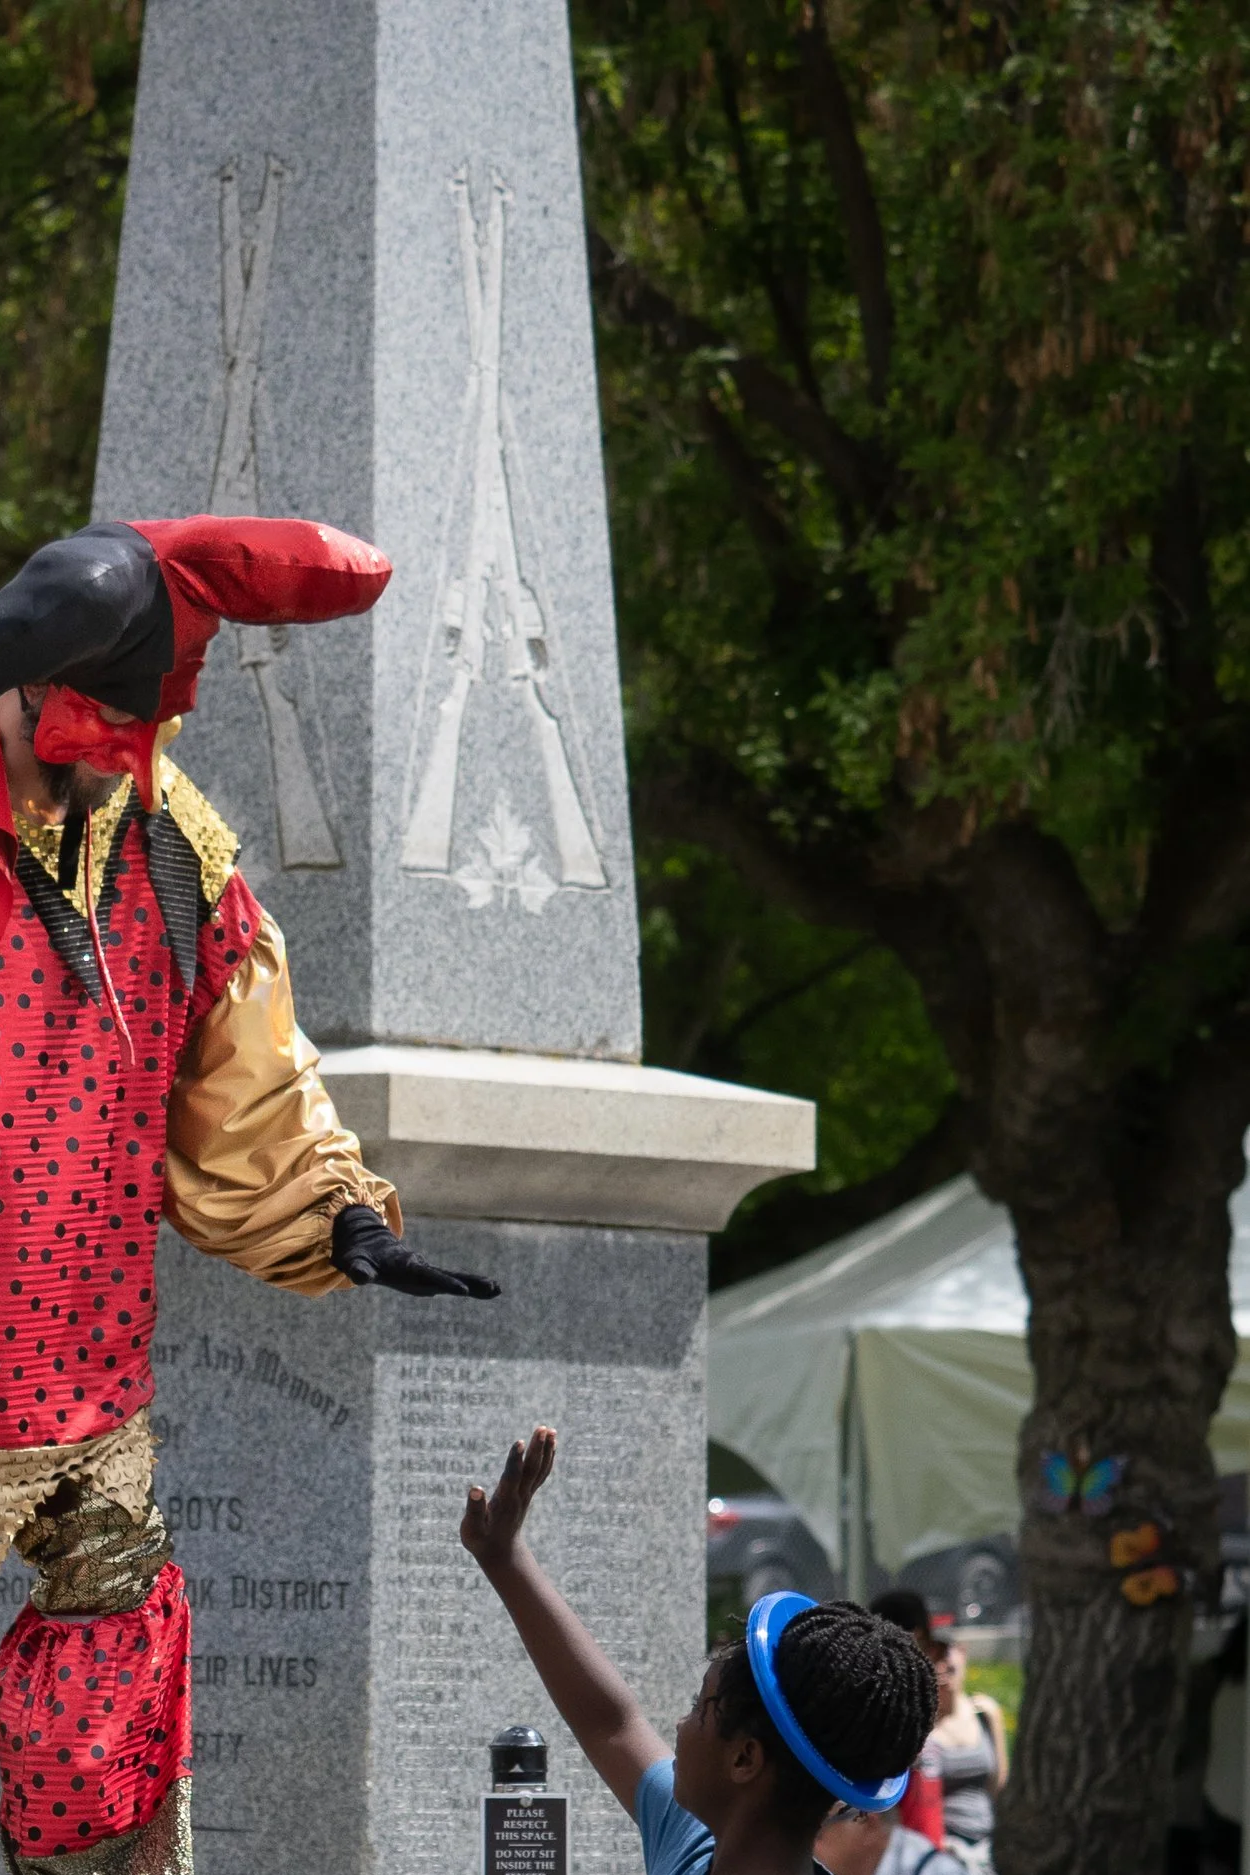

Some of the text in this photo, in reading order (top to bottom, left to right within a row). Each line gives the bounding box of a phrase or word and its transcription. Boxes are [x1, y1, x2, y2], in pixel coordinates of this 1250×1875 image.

[166, 1495, 244, 1532] BOYS
[231, 1575, 351, 1611] DISTRICT
[192, 1655, 318, 1687] EIR LIVES
[506, 1808, 545, 1818] PLEASE
[503, 1820, 549, 1829] RESPECT
[494, 1832, 557, 1841] THIS SPACE.
[495, 1850, 557, 1859] DO NOT SIT
[495, 1861, 556, 1870] INSIDE THE
